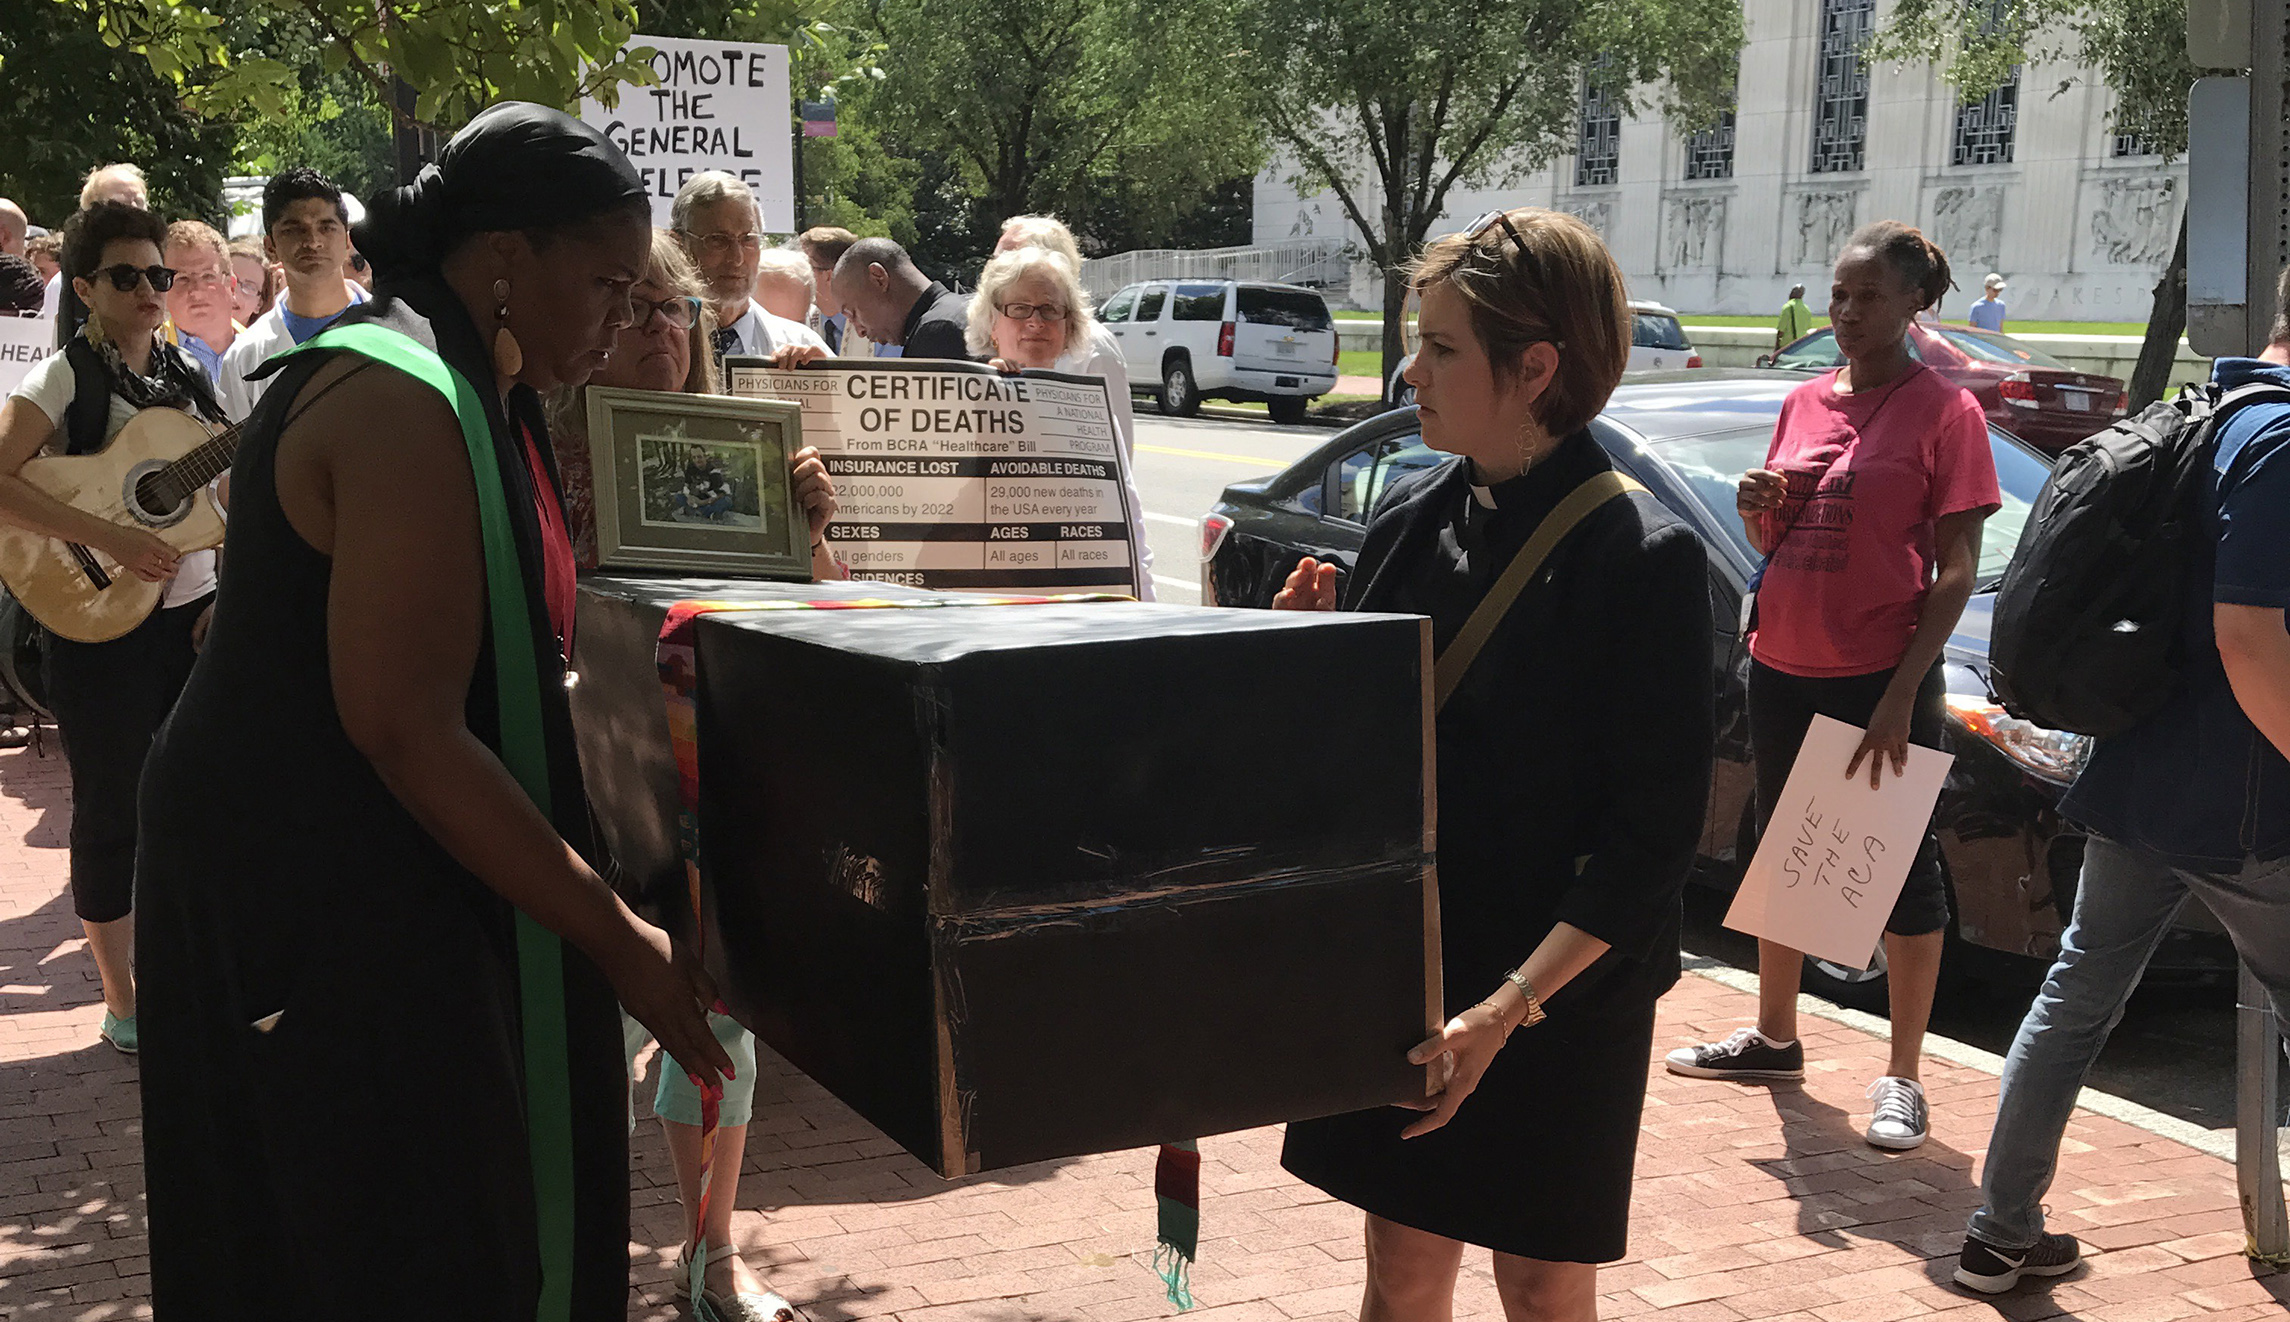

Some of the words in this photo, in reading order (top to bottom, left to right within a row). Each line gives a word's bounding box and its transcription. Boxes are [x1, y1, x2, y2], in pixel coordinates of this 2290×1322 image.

[613, 47, 766, 87] OMOTE
[650, 89, 715, 122] THE
[604, 120, 753, 157] GENERAL
[738, 378, 810, 391] PHYSICIANS
[813, 380, 838, 391] FOR
[847, 374, 1031, 403] CERTIFICATE
[1035, 388, 1082, 402] PHYSICIANS
[1084, 394, 1102, 404] FOR
[1057, 406, 1063, 416] A
[1065, 408, 1104, 420] NATIONAL
[860, 407, 901, 432] OF
[911, 409, 1025, 434] DEATHS
[1077, 425, 1107, 437] HEALTH
[847, 438, 883, 451] From
[887, 439, 928, 452] BCRA
[1018, 440, 1037, 453] Bill
[1069, 440, 1111, 453] PROGRAM
[829, 460, 917, 474] INSURANCE
[920, 461, 959, 474] LOST
[990, 462, 1062, 475] AVOIDABLE
[1064, 463, 1107, 477] DEATHS
[990, 486, 1031, 499] 29,000
[1034, 488, 1056, 498] new
[1059, 486, 1094, 498] deaths
[1095, 487, 1104, 498] in
[902, 502, 918, 517] by
[921, 503, 954, 515] 2022
[990, 503, 1009, 515] the
[1013, 503, 1039, 515] USA
[1042, 505, 1072, 517] every
[1074, 505, 1098, 517] year
[831, 526, 880, 539] SEXES
[990, 526, 1029, 539] AGES
[1060, 525, 1103, 538] RACES
[833, 550, 847, 561] All
[851, 550, 904, 564] genders
[990, 550, 1006, 561] All
[1009, 552, 1039, 564] ages
[1061, 549, 1075, 561] All
[1078, 551, 1108, 561] races
[851, 572, 925, 585] SIDENCES
[1783, 795, 1823, 888] SAVE
[1813, 818, 1850, 886] THE
[1841, 836, 1886, 909] ACA
